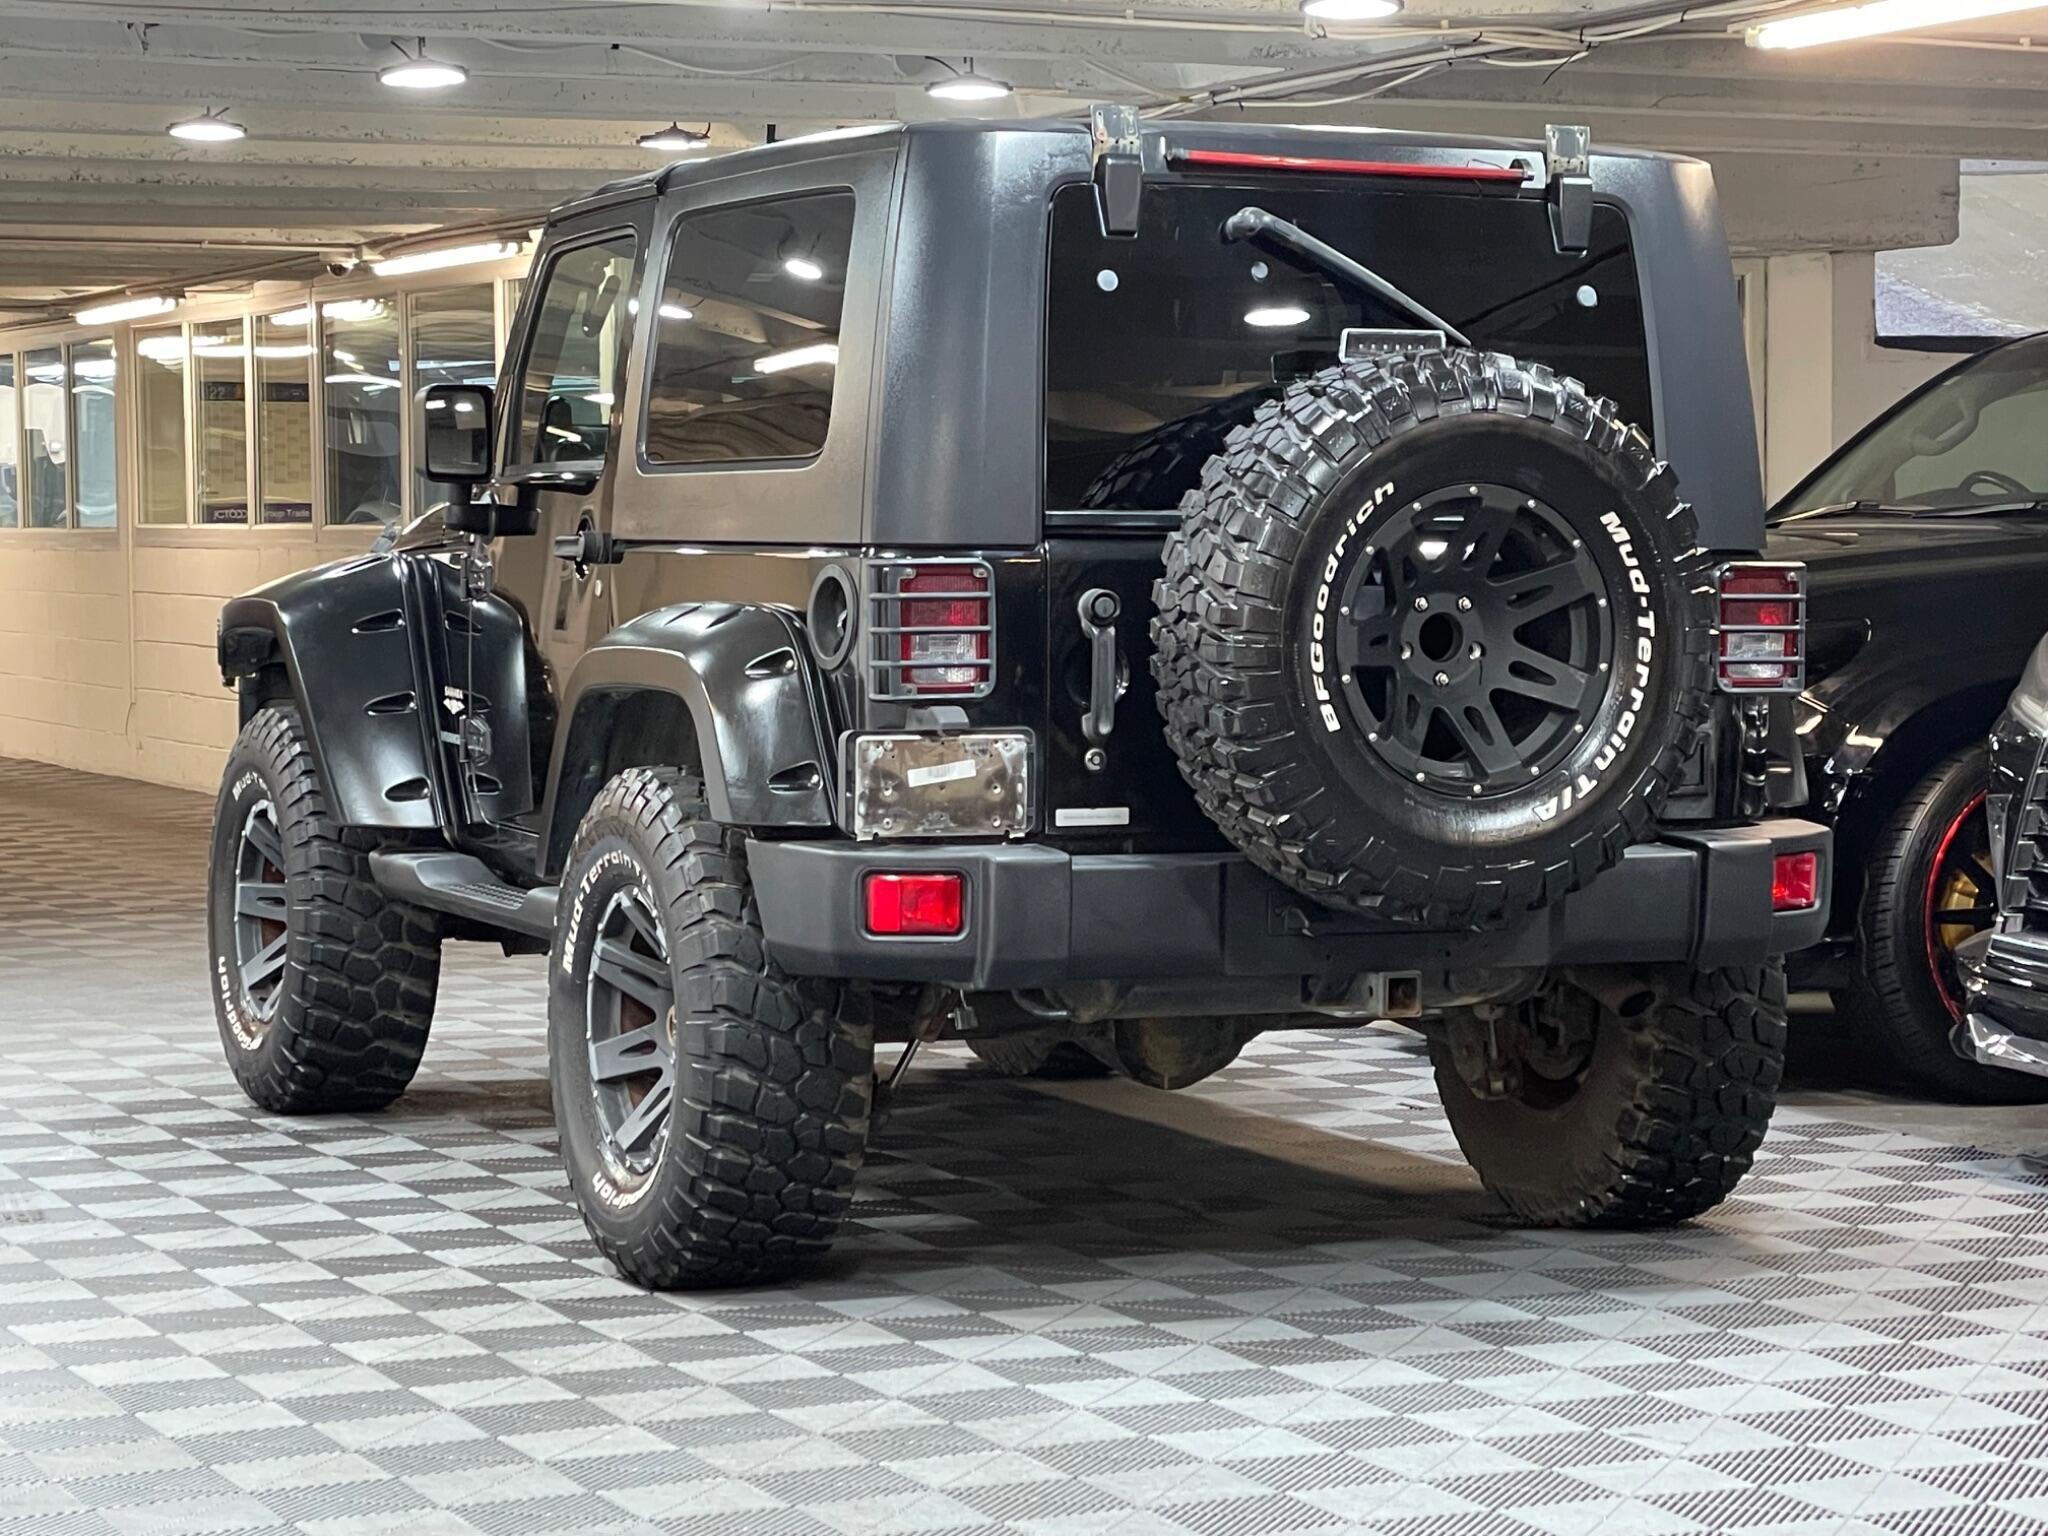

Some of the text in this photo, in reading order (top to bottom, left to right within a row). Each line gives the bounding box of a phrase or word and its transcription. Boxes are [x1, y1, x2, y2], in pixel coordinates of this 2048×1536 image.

[1309, 480, 1396, 733] BFGoodrich
[1594, 510, 1656, 772] Mud-Terrain
[562, 850, 632, 975] Mud-Terrain
